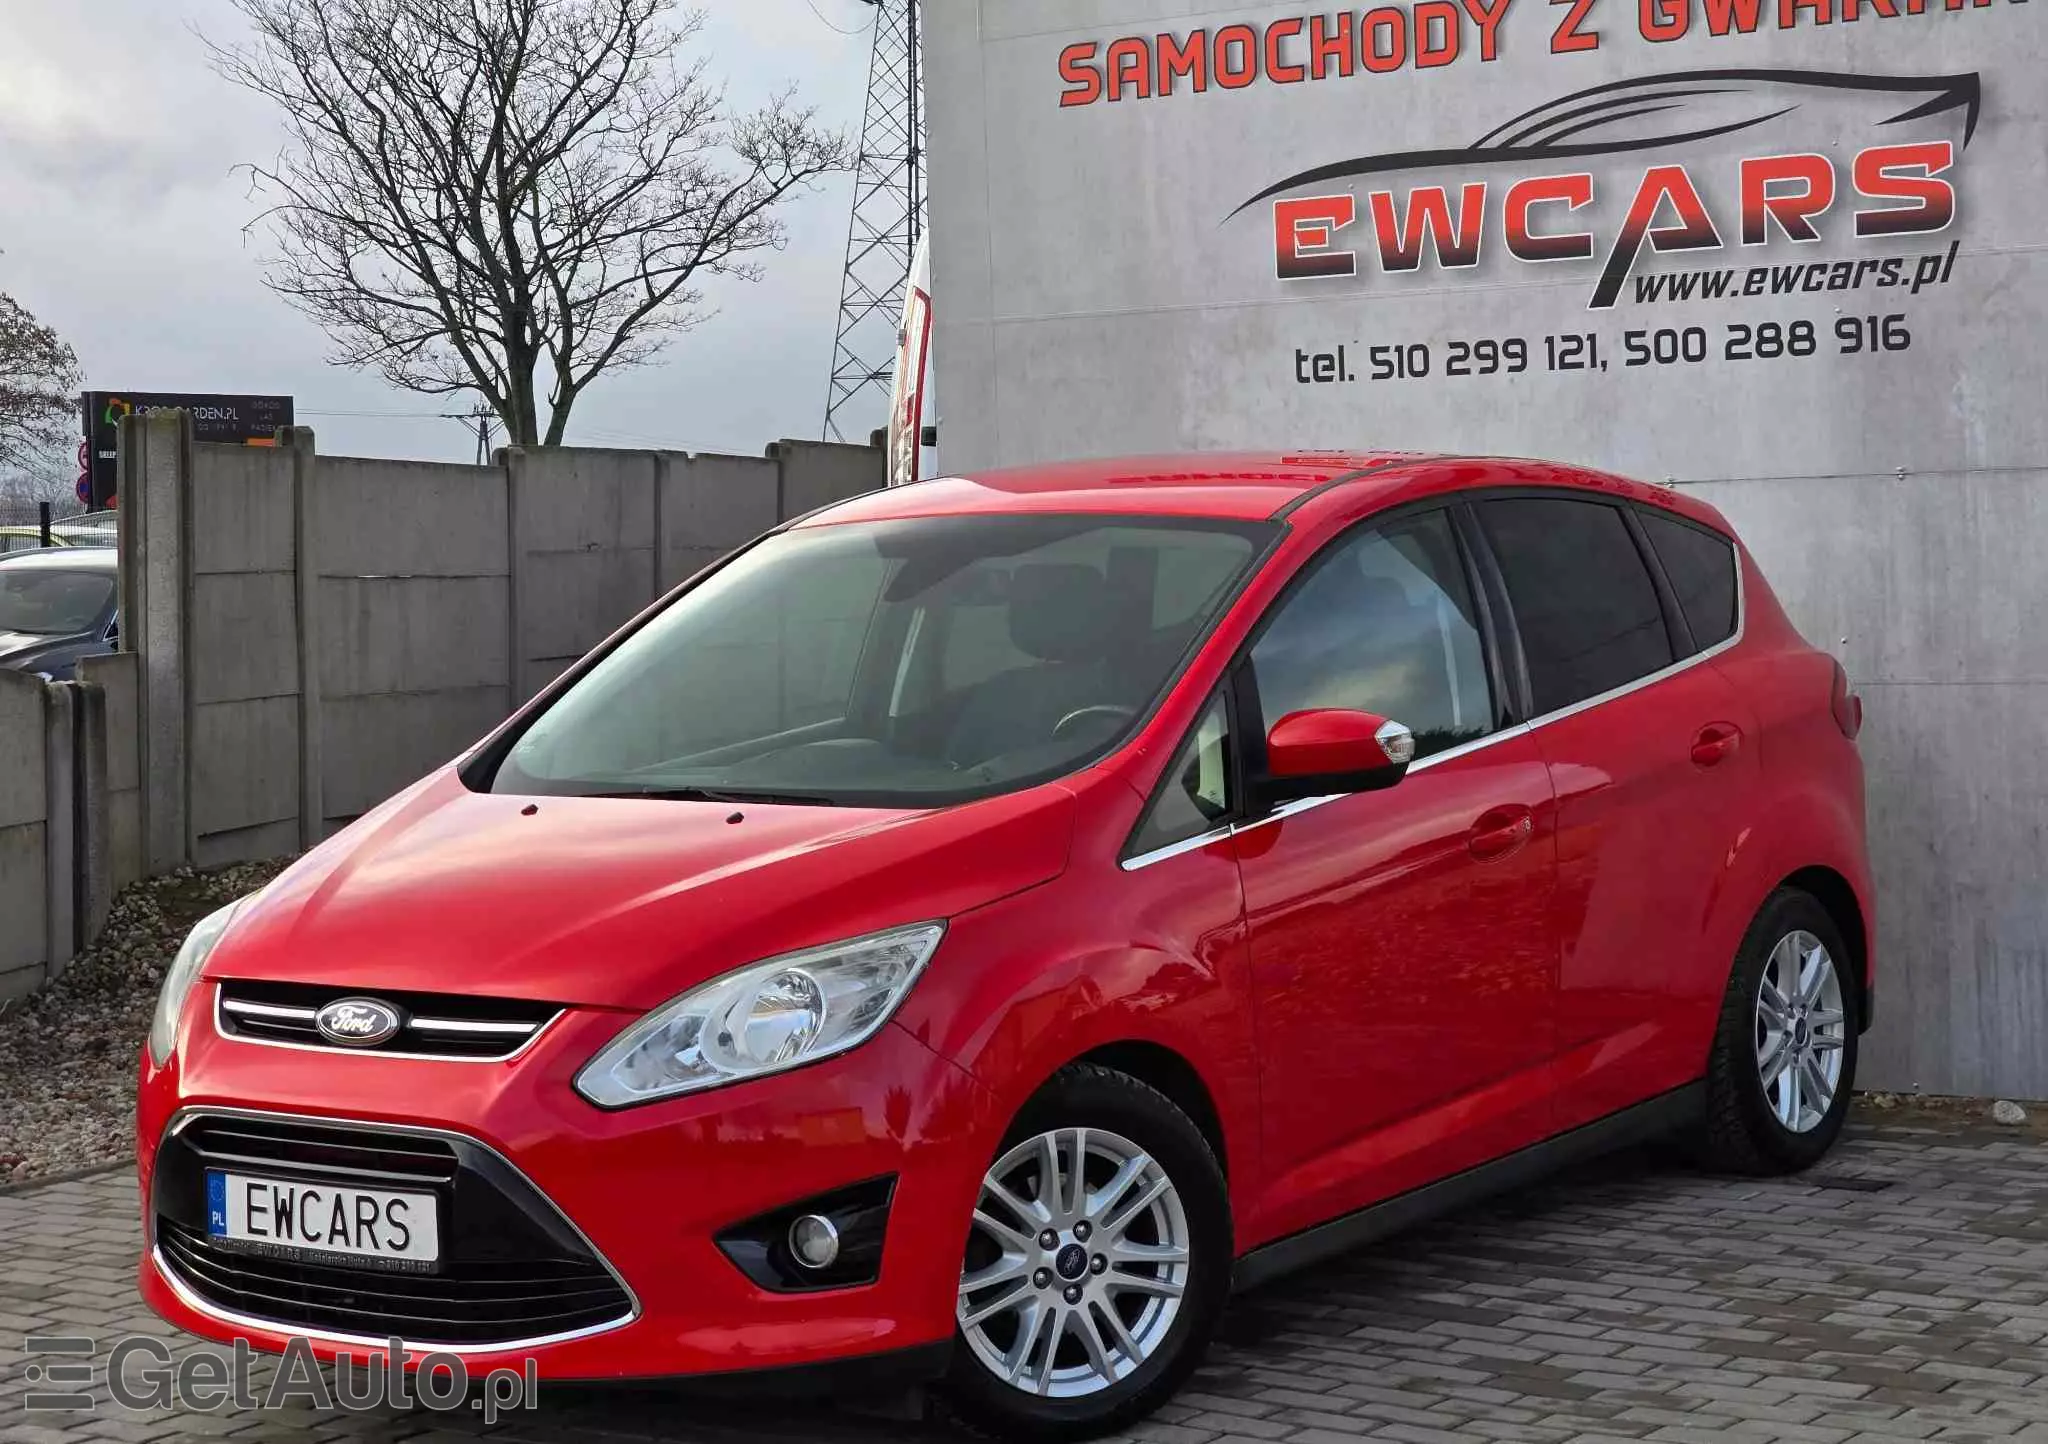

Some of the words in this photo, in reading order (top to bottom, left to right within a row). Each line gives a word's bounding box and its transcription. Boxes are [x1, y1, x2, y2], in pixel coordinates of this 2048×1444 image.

[1058, 0, 1513, 107] SAMOCHODY
[1549, 0, 1600, 54] Z
[1273, 140, 1956, 310] EWCARS
[1635, 240, 1960, 304] www.ewcars.pl
[1295, 345, 1354, 383] tel.
[1370, 344, 1429, 380] 510
[1446, 338, 1528, 376] 299
[1544, 333, 1608, 372] 121,
[1624, 326, 1707, 366] 500
[1725, 320, 1817, 360] 288
[1834, 313, 1911, 354] 916
[331, 1005, 377, 1033] Ford
[212, 1210, 225, 1226] PL
[246, 1182, 410, 1251] EWCARS
